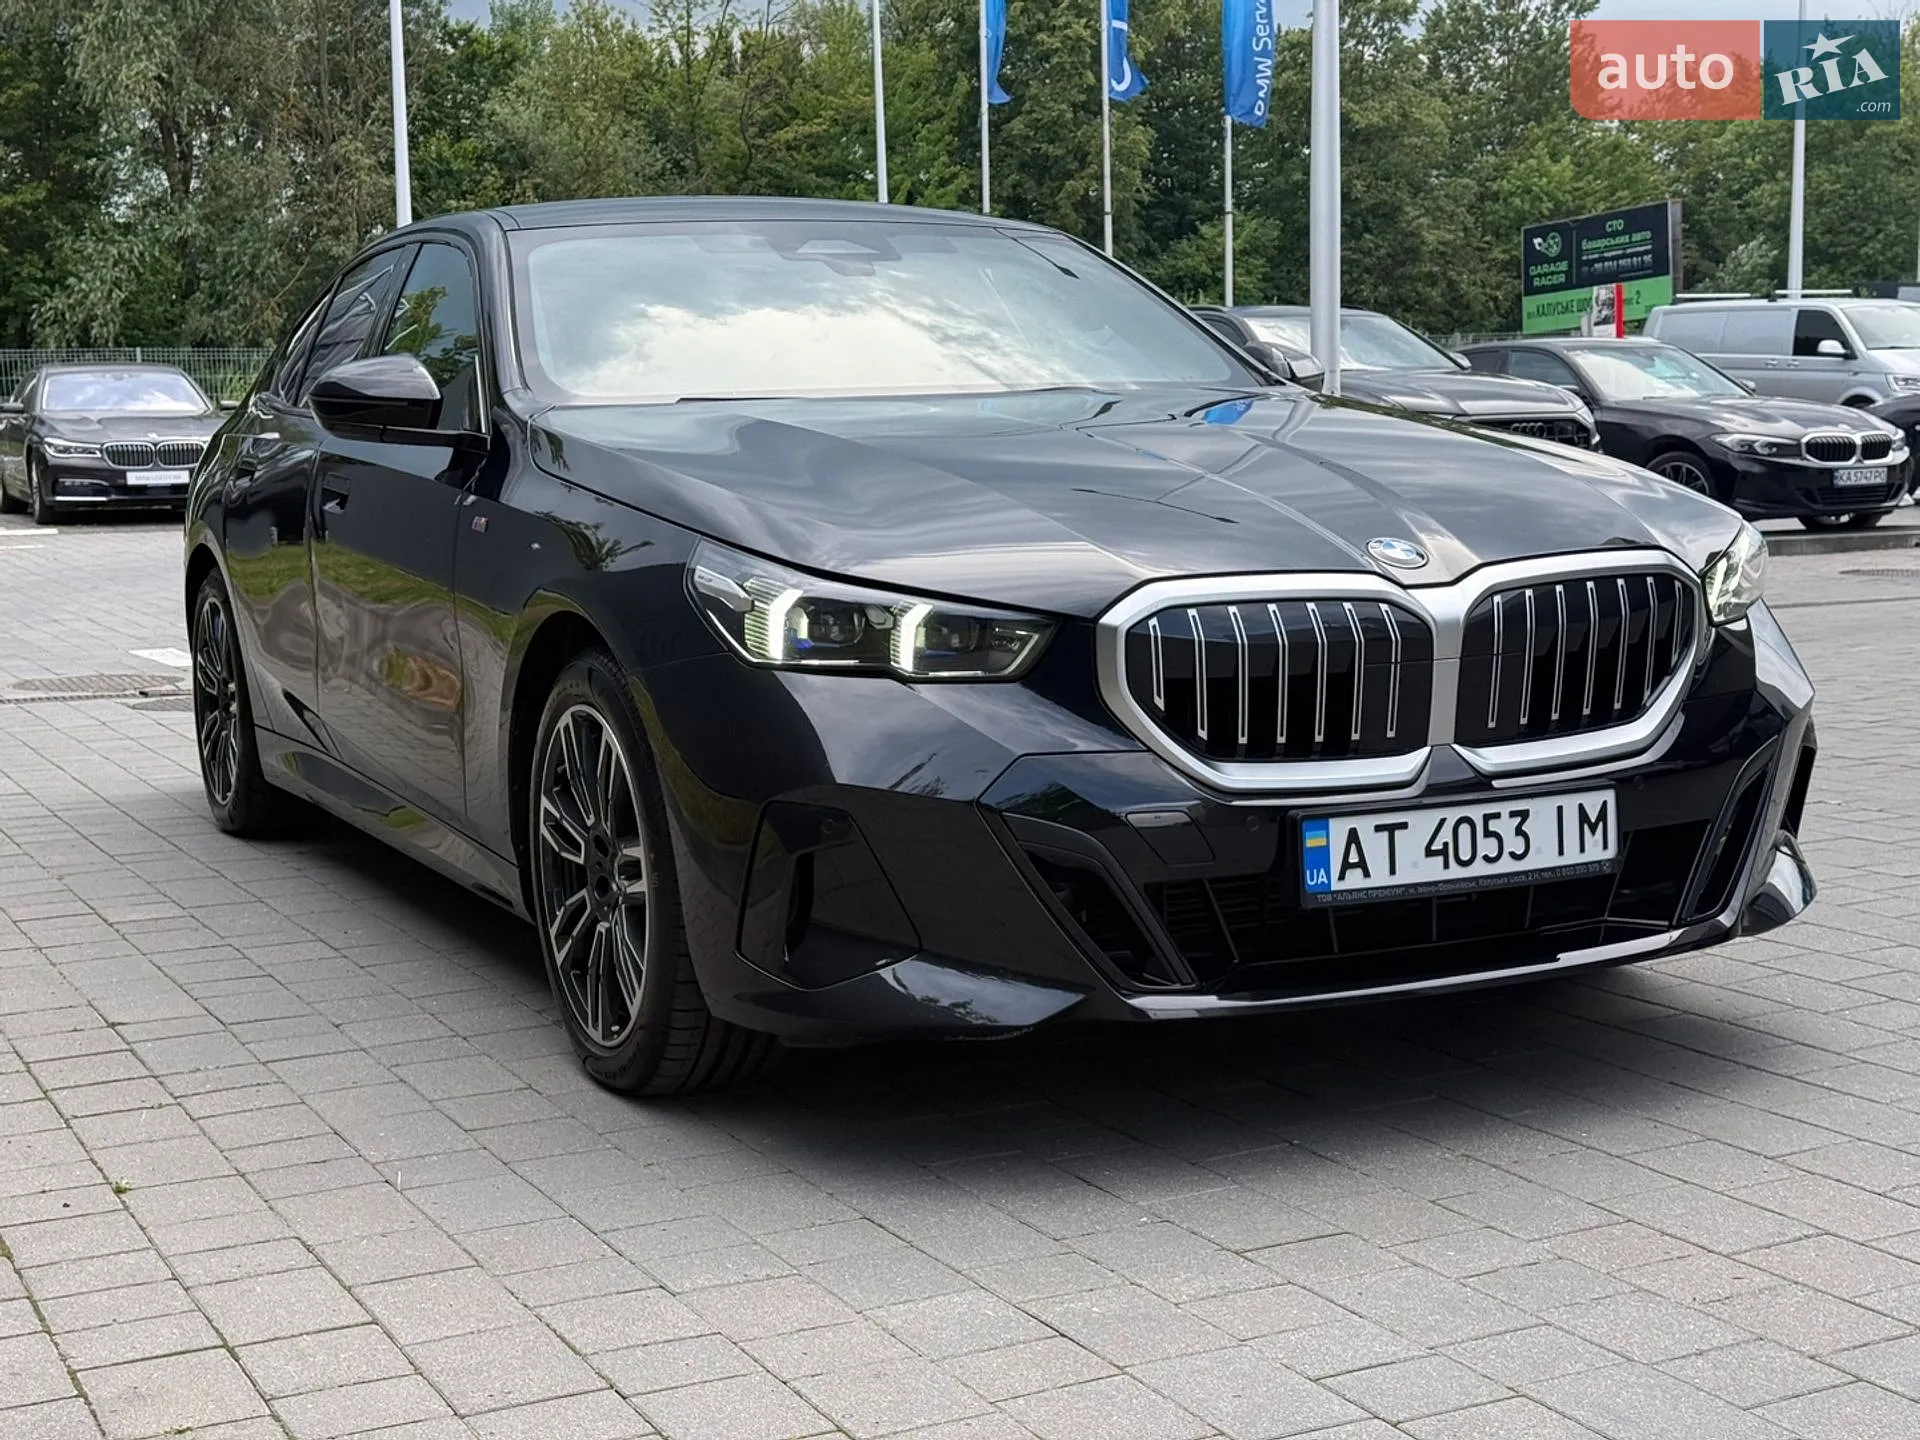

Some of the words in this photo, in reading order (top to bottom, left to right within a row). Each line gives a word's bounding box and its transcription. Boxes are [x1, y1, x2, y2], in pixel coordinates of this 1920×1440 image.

[1529, 260, 1569, 276] GARAGE
[1533, 273, 1566, 288] RACER
[1337, 821, 1409, 881] AT
[1424, 808, 1531, 870] 4053
[1556, 799, 1609, 857] IM
[1306, 868, 1328, 886] UA
